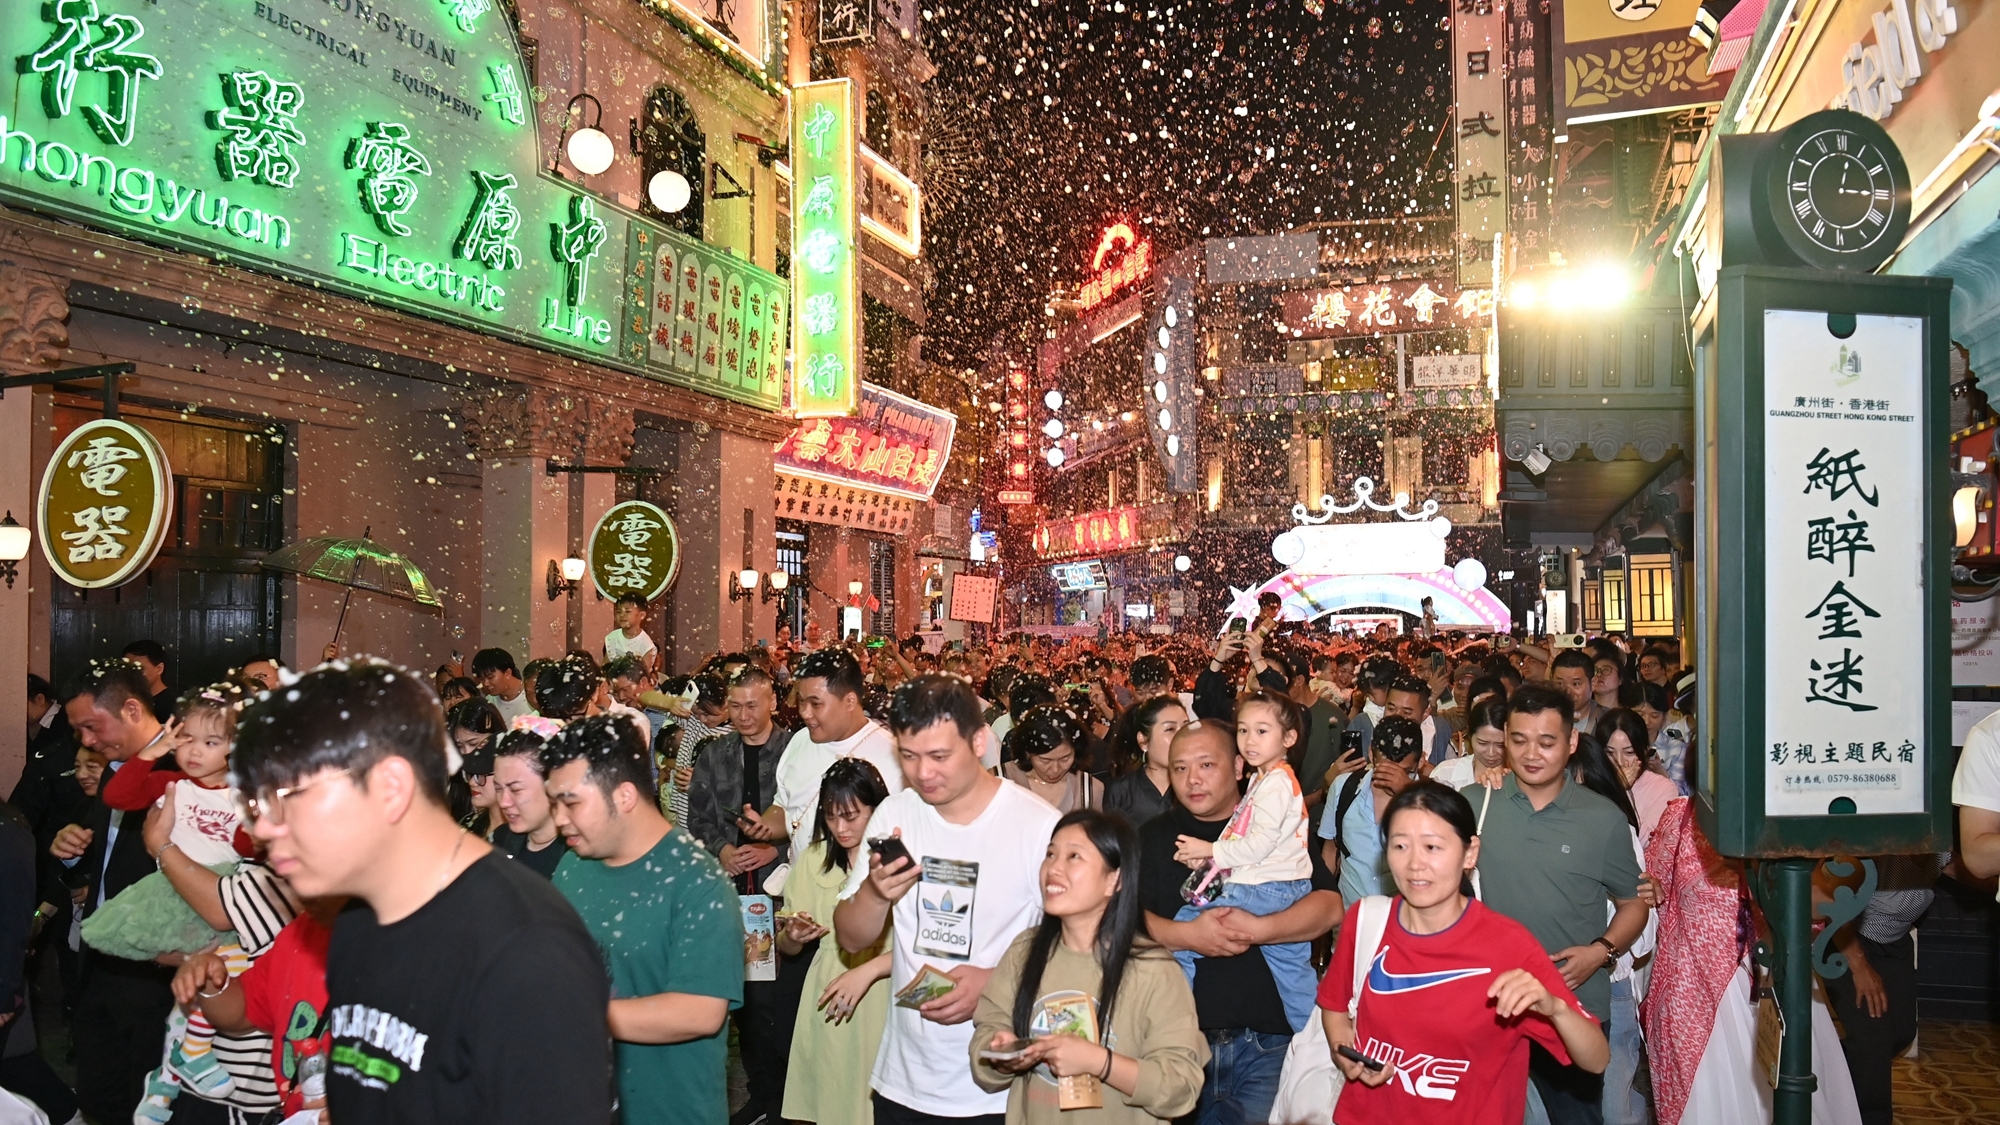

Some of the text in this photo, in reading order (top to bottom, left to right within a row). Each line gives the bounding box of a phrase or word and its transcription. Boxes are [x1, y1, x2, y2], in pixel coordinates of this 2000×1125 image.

[253, 2, 370, 69] ELECTRICAL
[391, 67, 483, 122] EQUIPMENT
[800, 101, 844, 398] 中原電器行
[655, 254, 673, 350] 電話機
[680, 266, 698, 357] 電視機
[1769, 409, 1815, 418] GUANGZHOU
[1816, 412, 1842, 420] STREET
[1844, 413, 1865, 421] HONG
[61, 436, 139, 564] 電器
[605, 512, 661, 589] 電器
[1827, 773, 1897, 783] 0579-86380688
[921, 927, 967, 946] adidas
